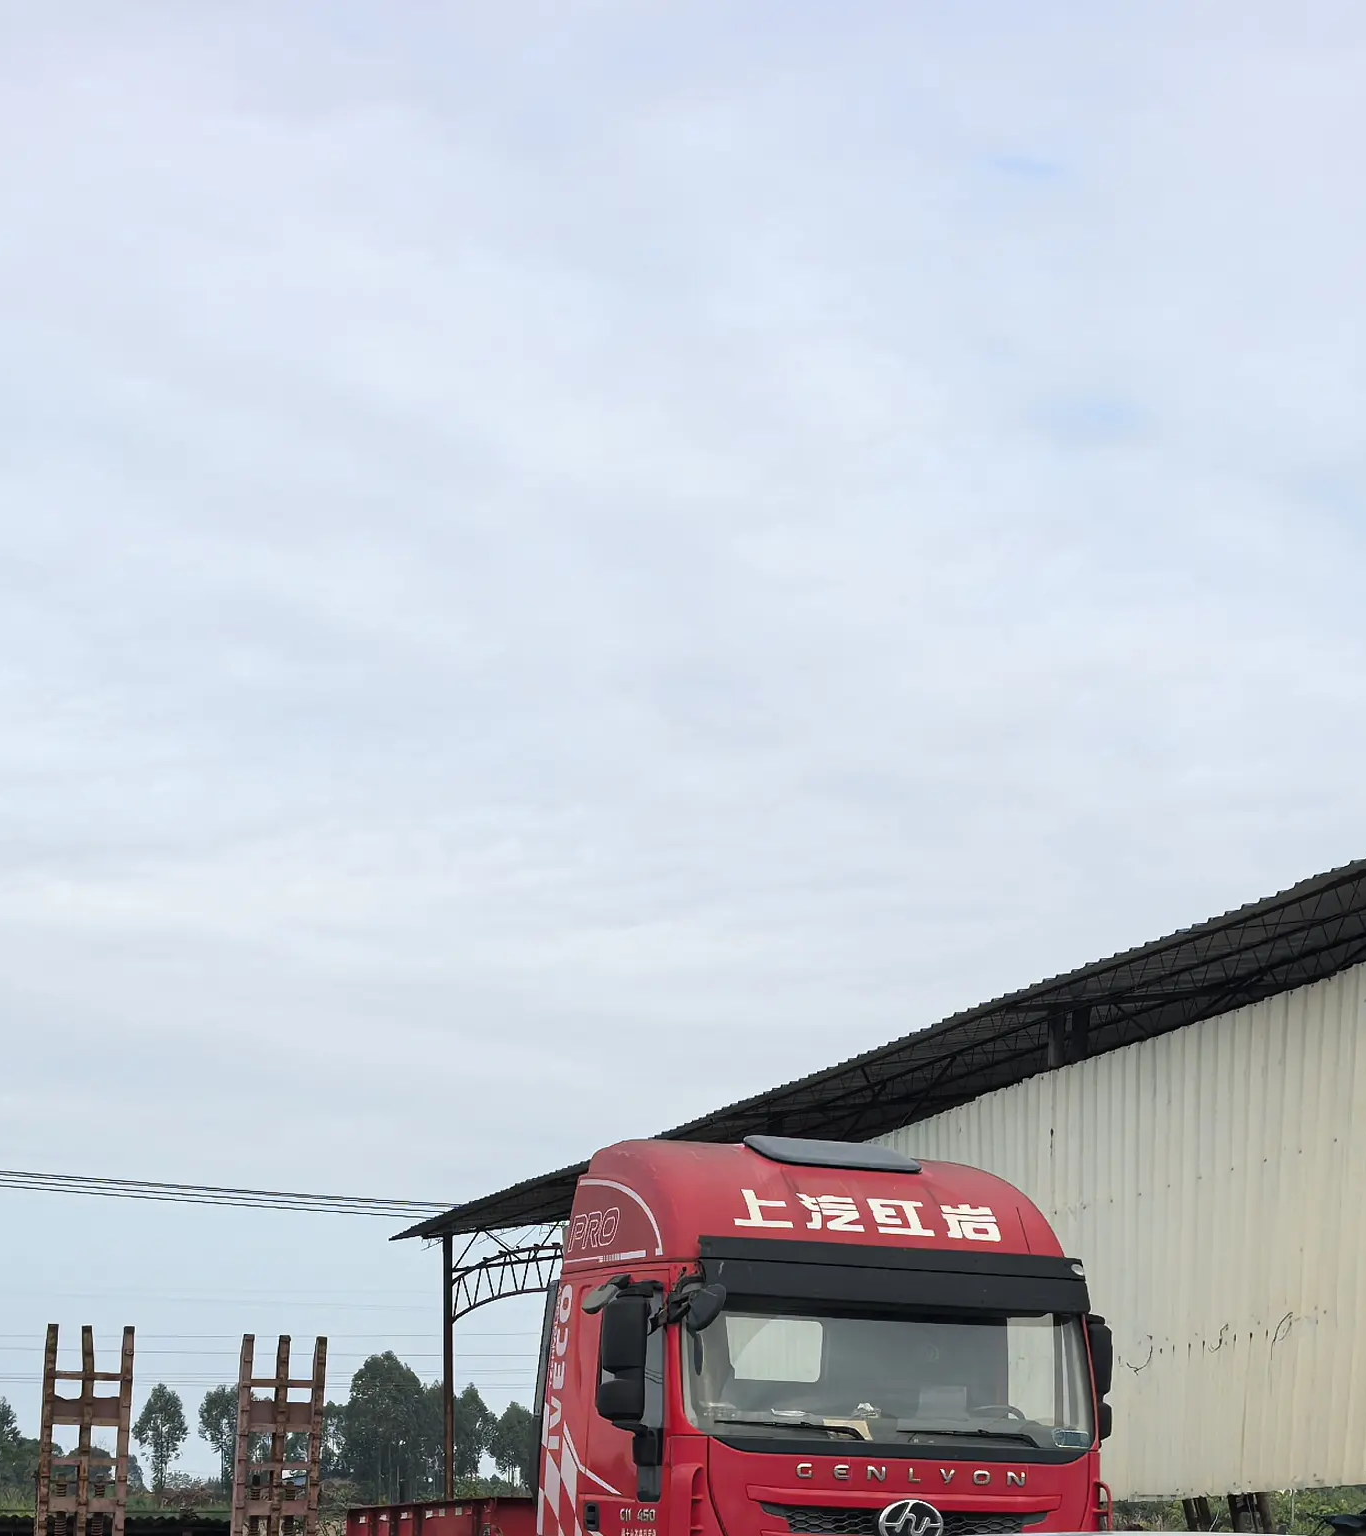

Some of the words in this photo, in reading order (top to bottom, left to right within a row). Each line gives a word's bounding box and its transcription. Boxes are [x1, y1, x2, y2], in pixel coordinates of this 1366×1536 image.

[567, 1206, 620, 1253] PRO
[733, 1188, 1002, 1243] 上汽红岩
[547, 1284, 573, 1450] IVECO
[796, 1462, 1026, 1488] GENLYON
